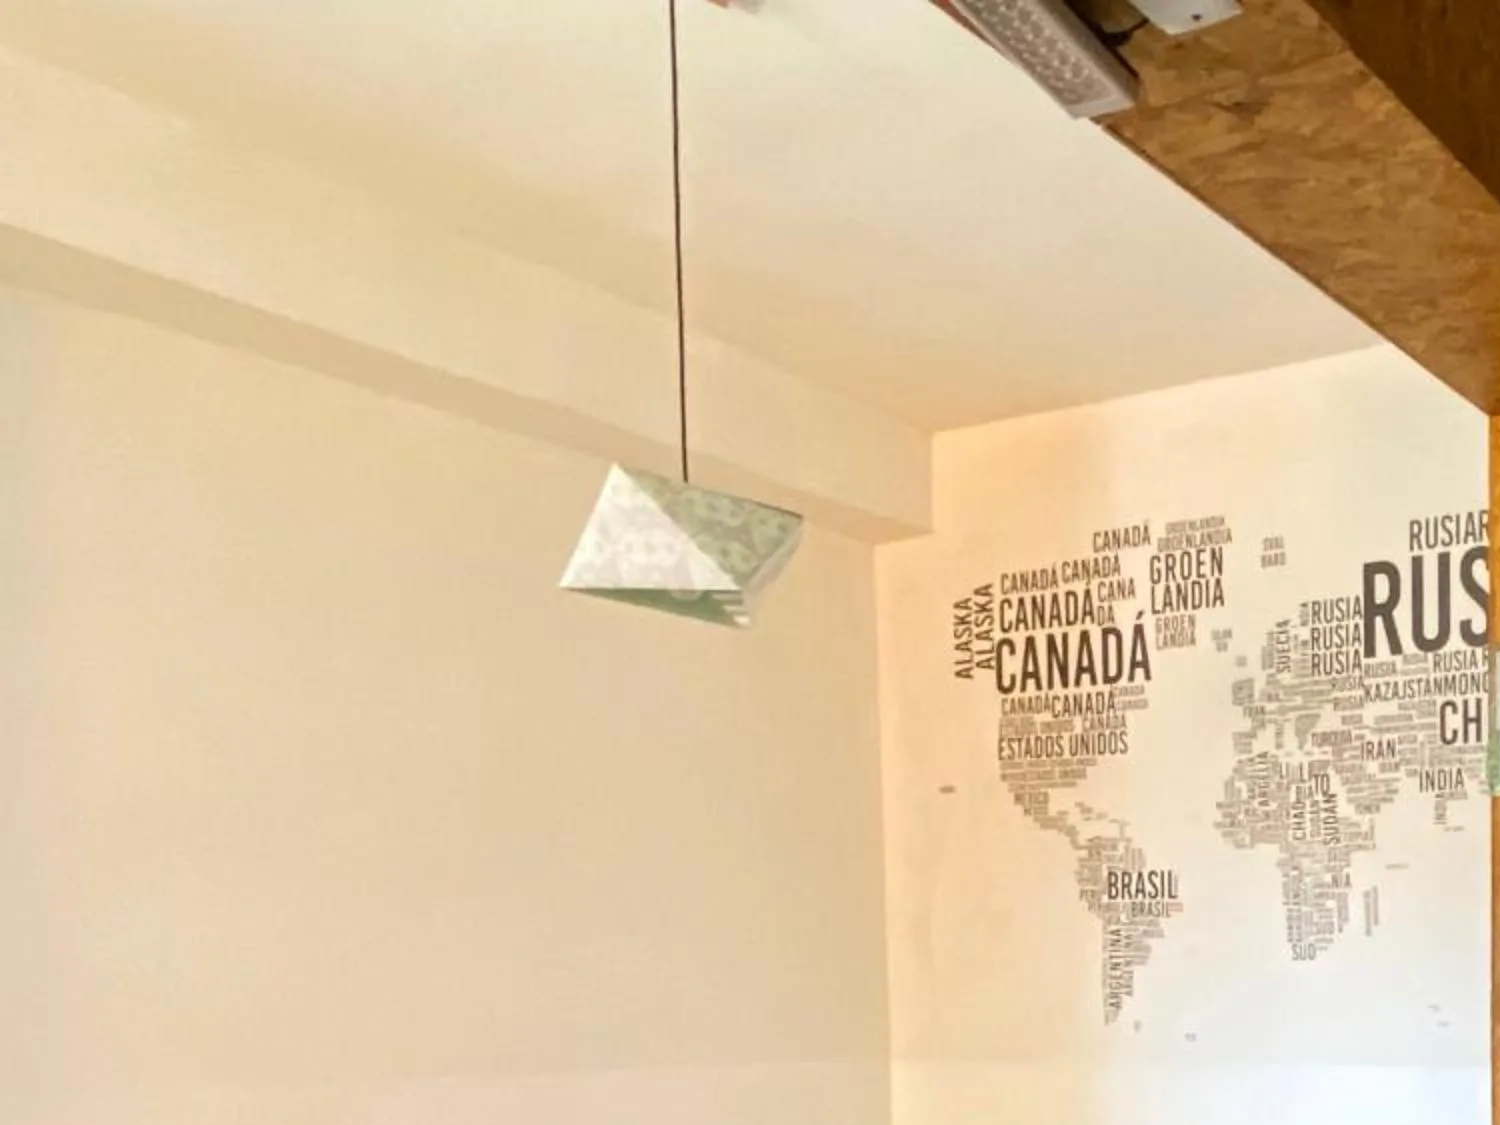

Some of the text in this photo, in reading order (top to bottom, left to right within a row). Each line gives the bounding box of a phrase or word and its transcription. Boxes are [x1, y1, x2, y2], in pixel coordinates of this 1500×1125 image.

[1150, 547, 1224, 585] GROEN
[1097, 577, 1136, 603] CANA
[1151, 578, 1226, 615] LANDIA
[1310, 595, 1363, 625] RUSIA
[952, 597, 974, 680] ALASKA
[972, 583, 996, 671] ALASKA
[1310, 623, 1363, 652] RUSIA
[994, 609, 1152, 694] CANADÁ
[1276, 619, 1291, 674] SUECIA
[1310, 649, 1363, 677] RUSIA
[1432, 650, 1477, 674] RUSIA
[1363, 678, 1442, 703] KAZAJSTAN
[998, 730, 1129, 761] ESTADOS UNIDOS
[1361, 735, 1397, 761] IRAN
[1419, 767, 1465, 793] INDIA
[1106, 869, 1179, 900] BRASIL
[1130, 901, 1171, 918] BRASIL
